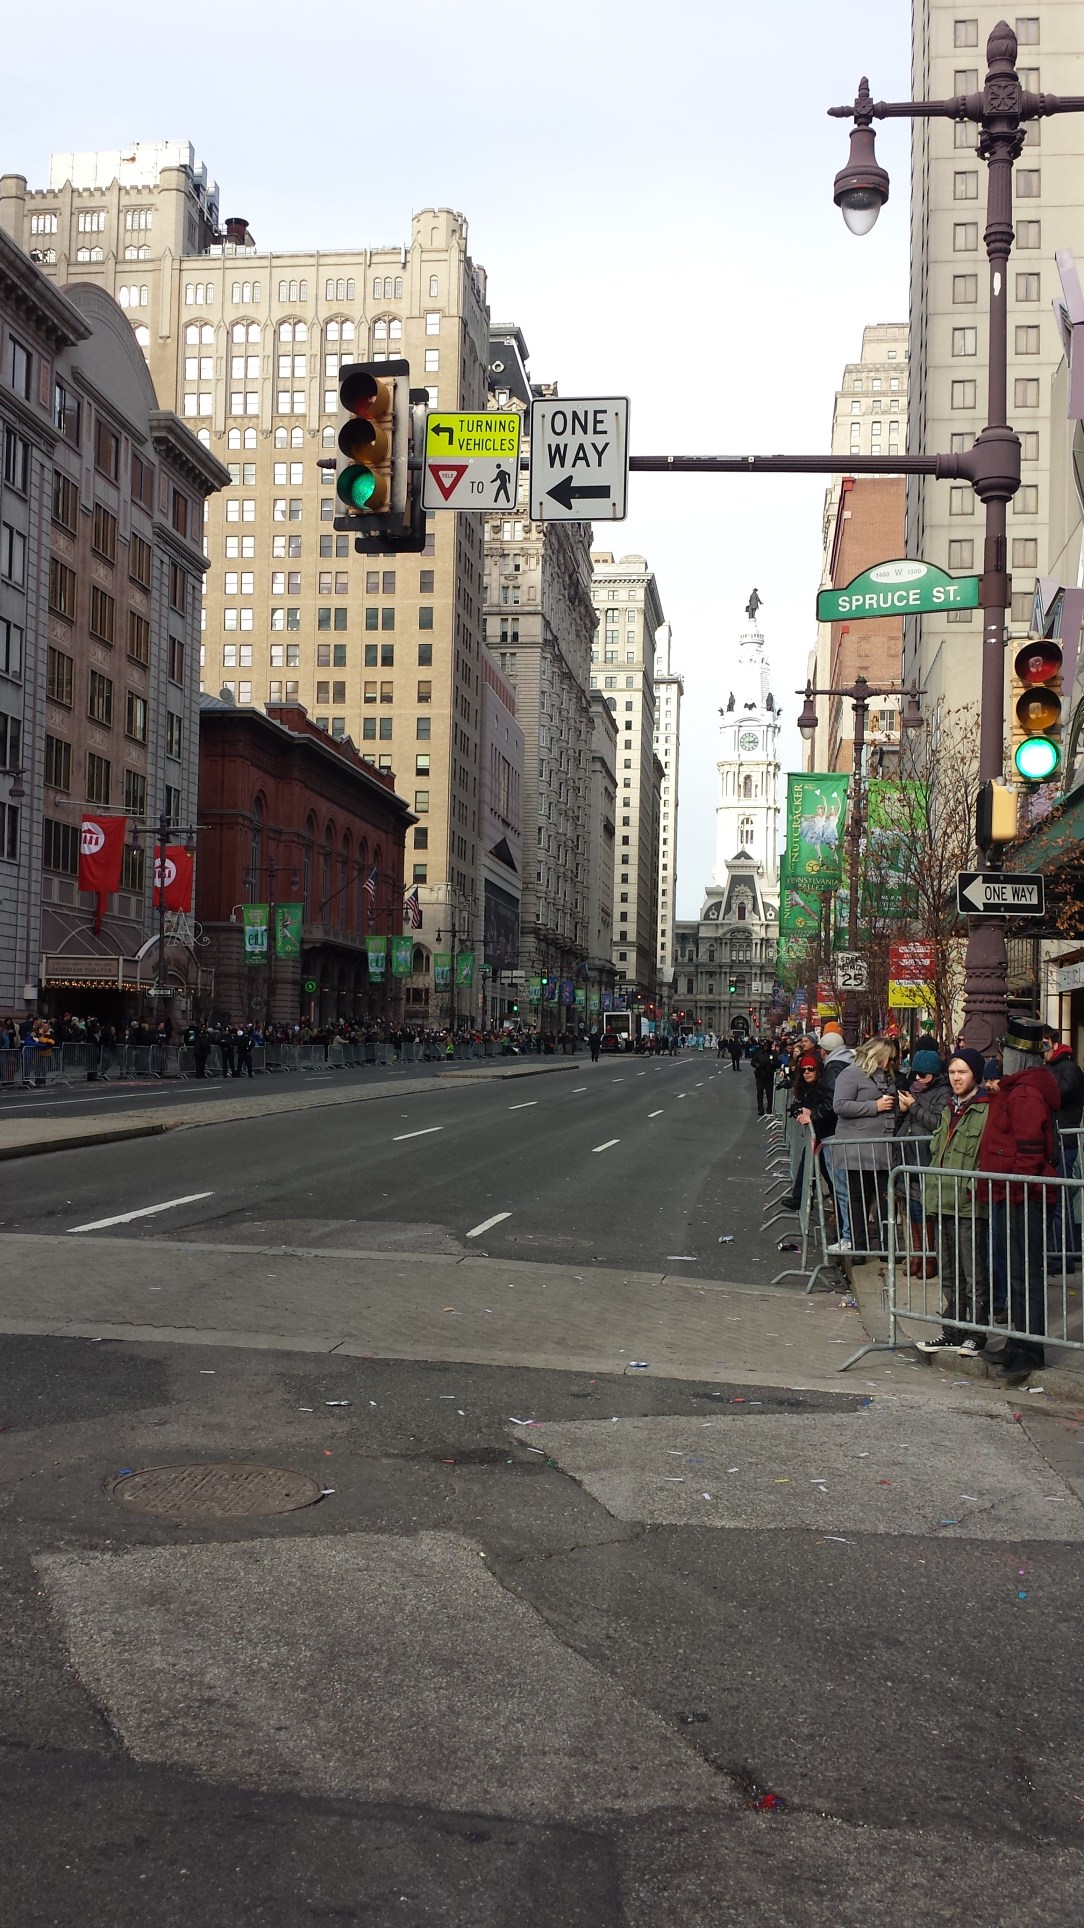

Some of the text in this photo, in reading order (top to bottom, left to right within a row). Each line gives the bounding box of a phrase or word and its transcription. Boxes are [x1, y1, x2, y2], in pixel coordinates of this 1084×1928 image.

[459, 419, 515, 433] TURNING
[551, 409, 608, 437] ONE
[458, 438, 515, 451] VEHICLES
[547, 442, 610, 468] WAY
[470, 481, 484, 494] TO
[894, 568, 903, 576] W
[838, 585, 961, 612] SPRUCE ST.
[791, 783, 803, 862] NUTCRACKER
[787, 877, 839, 886] PENNSYLVANIA
[984, 885, 1035, 902] ONE WAY
[842, 973, 864, 987] 25
